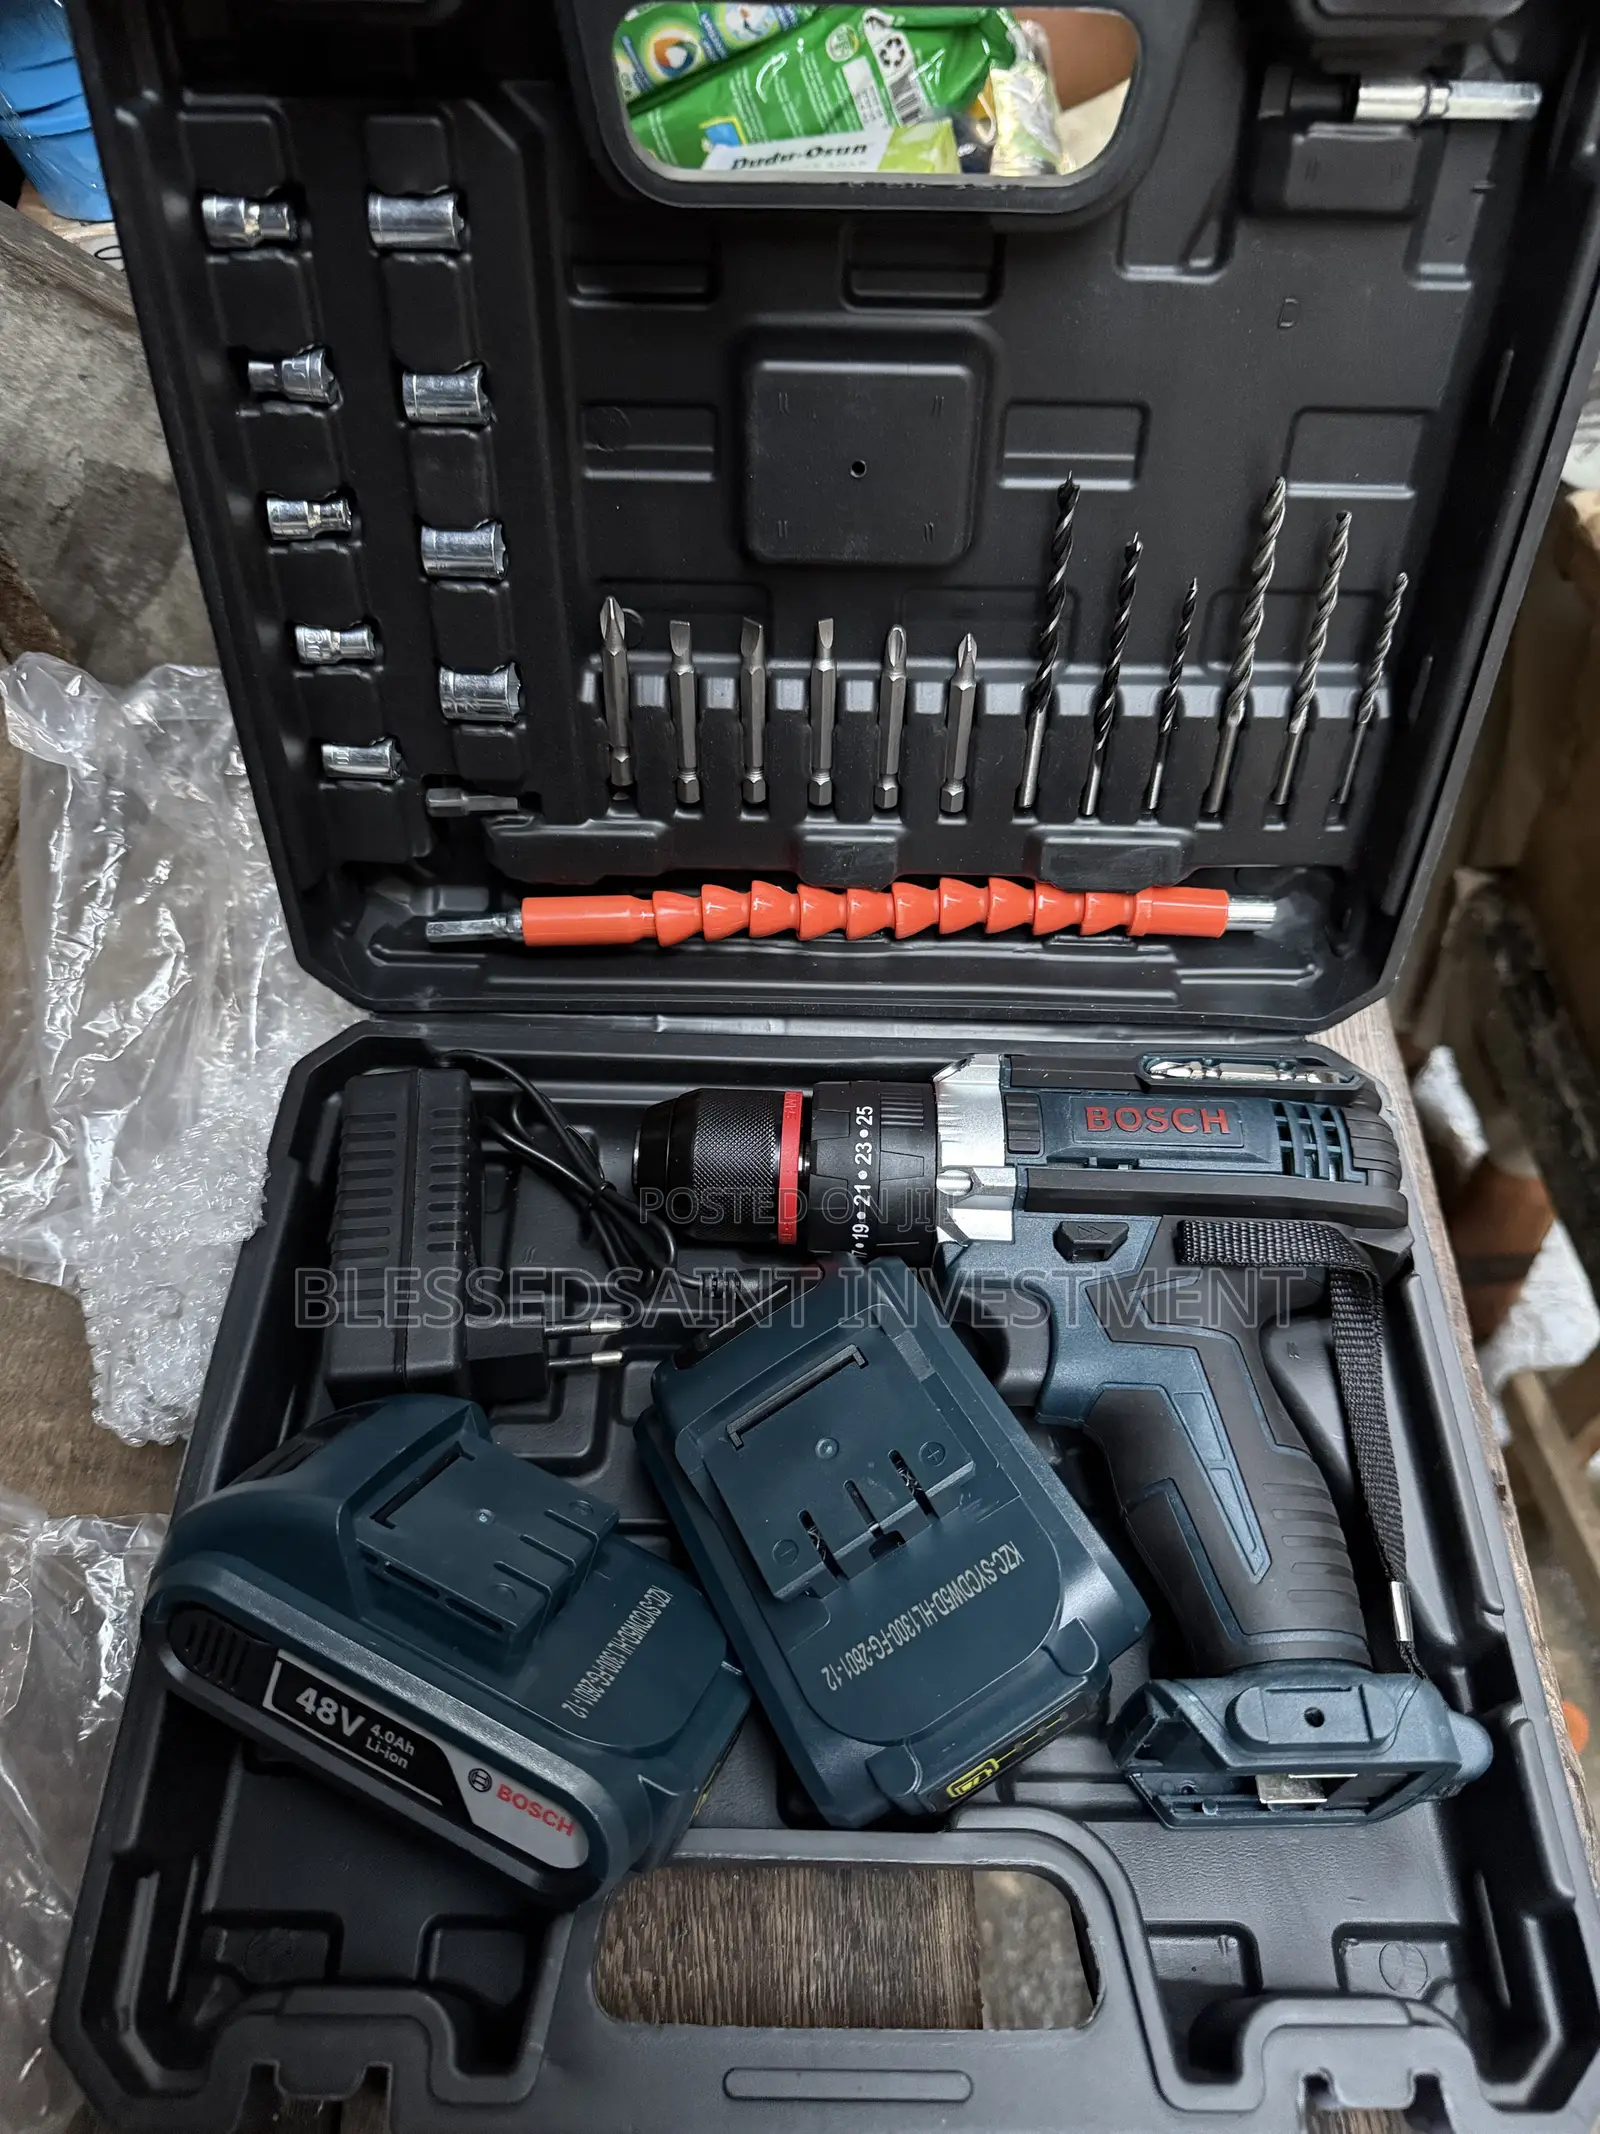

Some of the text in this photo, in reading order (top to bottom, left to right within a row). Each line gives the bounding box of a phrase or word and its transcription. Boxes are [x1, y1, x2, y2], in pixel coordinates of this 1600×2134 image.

[731, 143, 868, 171] Dudu-Osun
[856, 1106, 873, 1126] 25
[1085, 1106, 1230, 1134] BOSCH
[855, 1142, 873, 1166] 23
[853, 1184, 872, 1207] 21
[852, 1223, 870, 1240] 19
[295, 1686, 366, 1738] 48V
[365, 1736, 409, 1770] Li-ion
[369, 1723, 416, 1757] 4.0Ah
[496, 1783, 576, 1837] BOSCH
